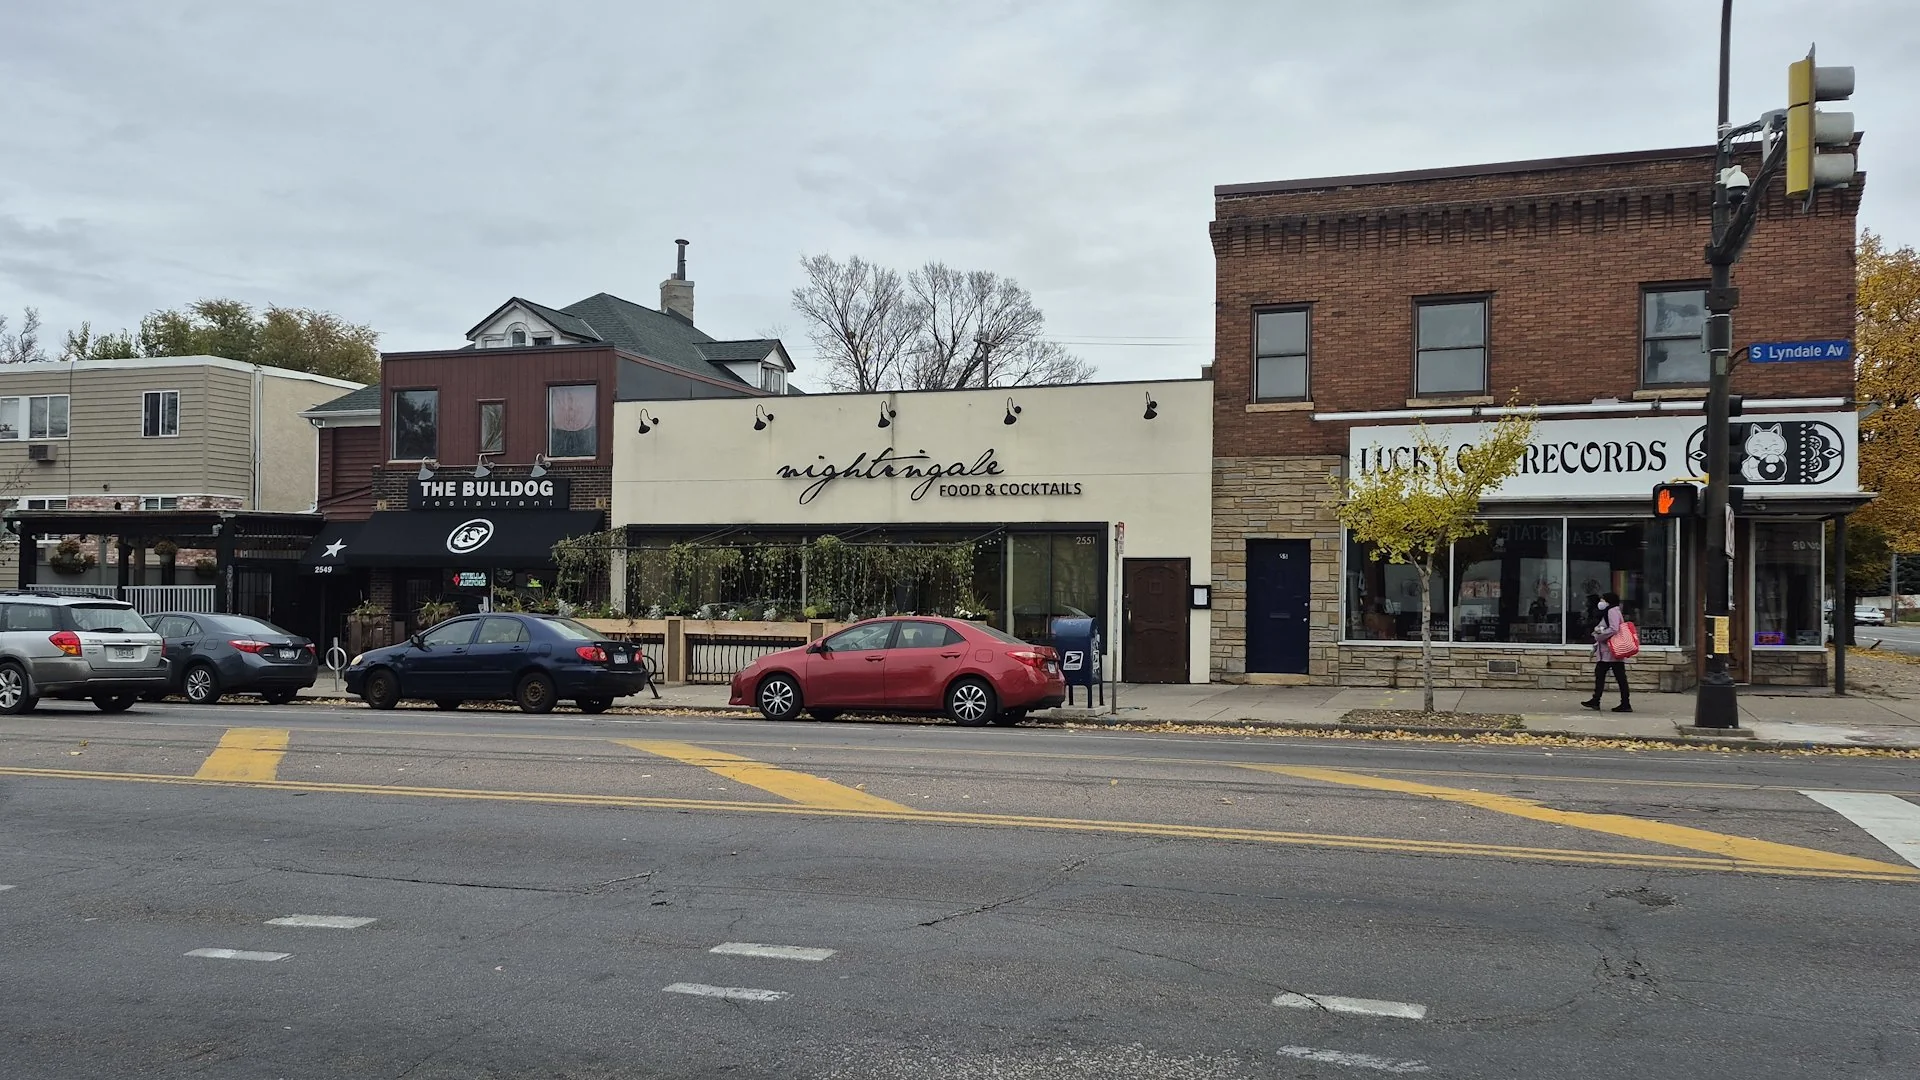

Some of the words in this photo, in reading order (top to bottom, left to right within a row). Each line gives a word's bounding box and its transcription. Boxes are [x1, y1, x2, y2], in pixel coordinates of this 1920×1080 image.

[1752, 346, 1762, 359] S
[1769, 345, 1822, 361] Lyndale
[1825, 344, 1844, 356] Av
[1522, 440, 1667, 474] RECORDS
[776, 447, 1004, 505] nightingale
[420, 481, 456, 497] THE
[462, 480, 554, 497] BULLDOG
[939, 484, 981, 497] FOOD
[985, 484, 997, 496] &
[999, 482, 1082, 496] COCKTAILS
[1075, 536, 1096, 545] 2551
[314, 565, 333, 574] 2549
